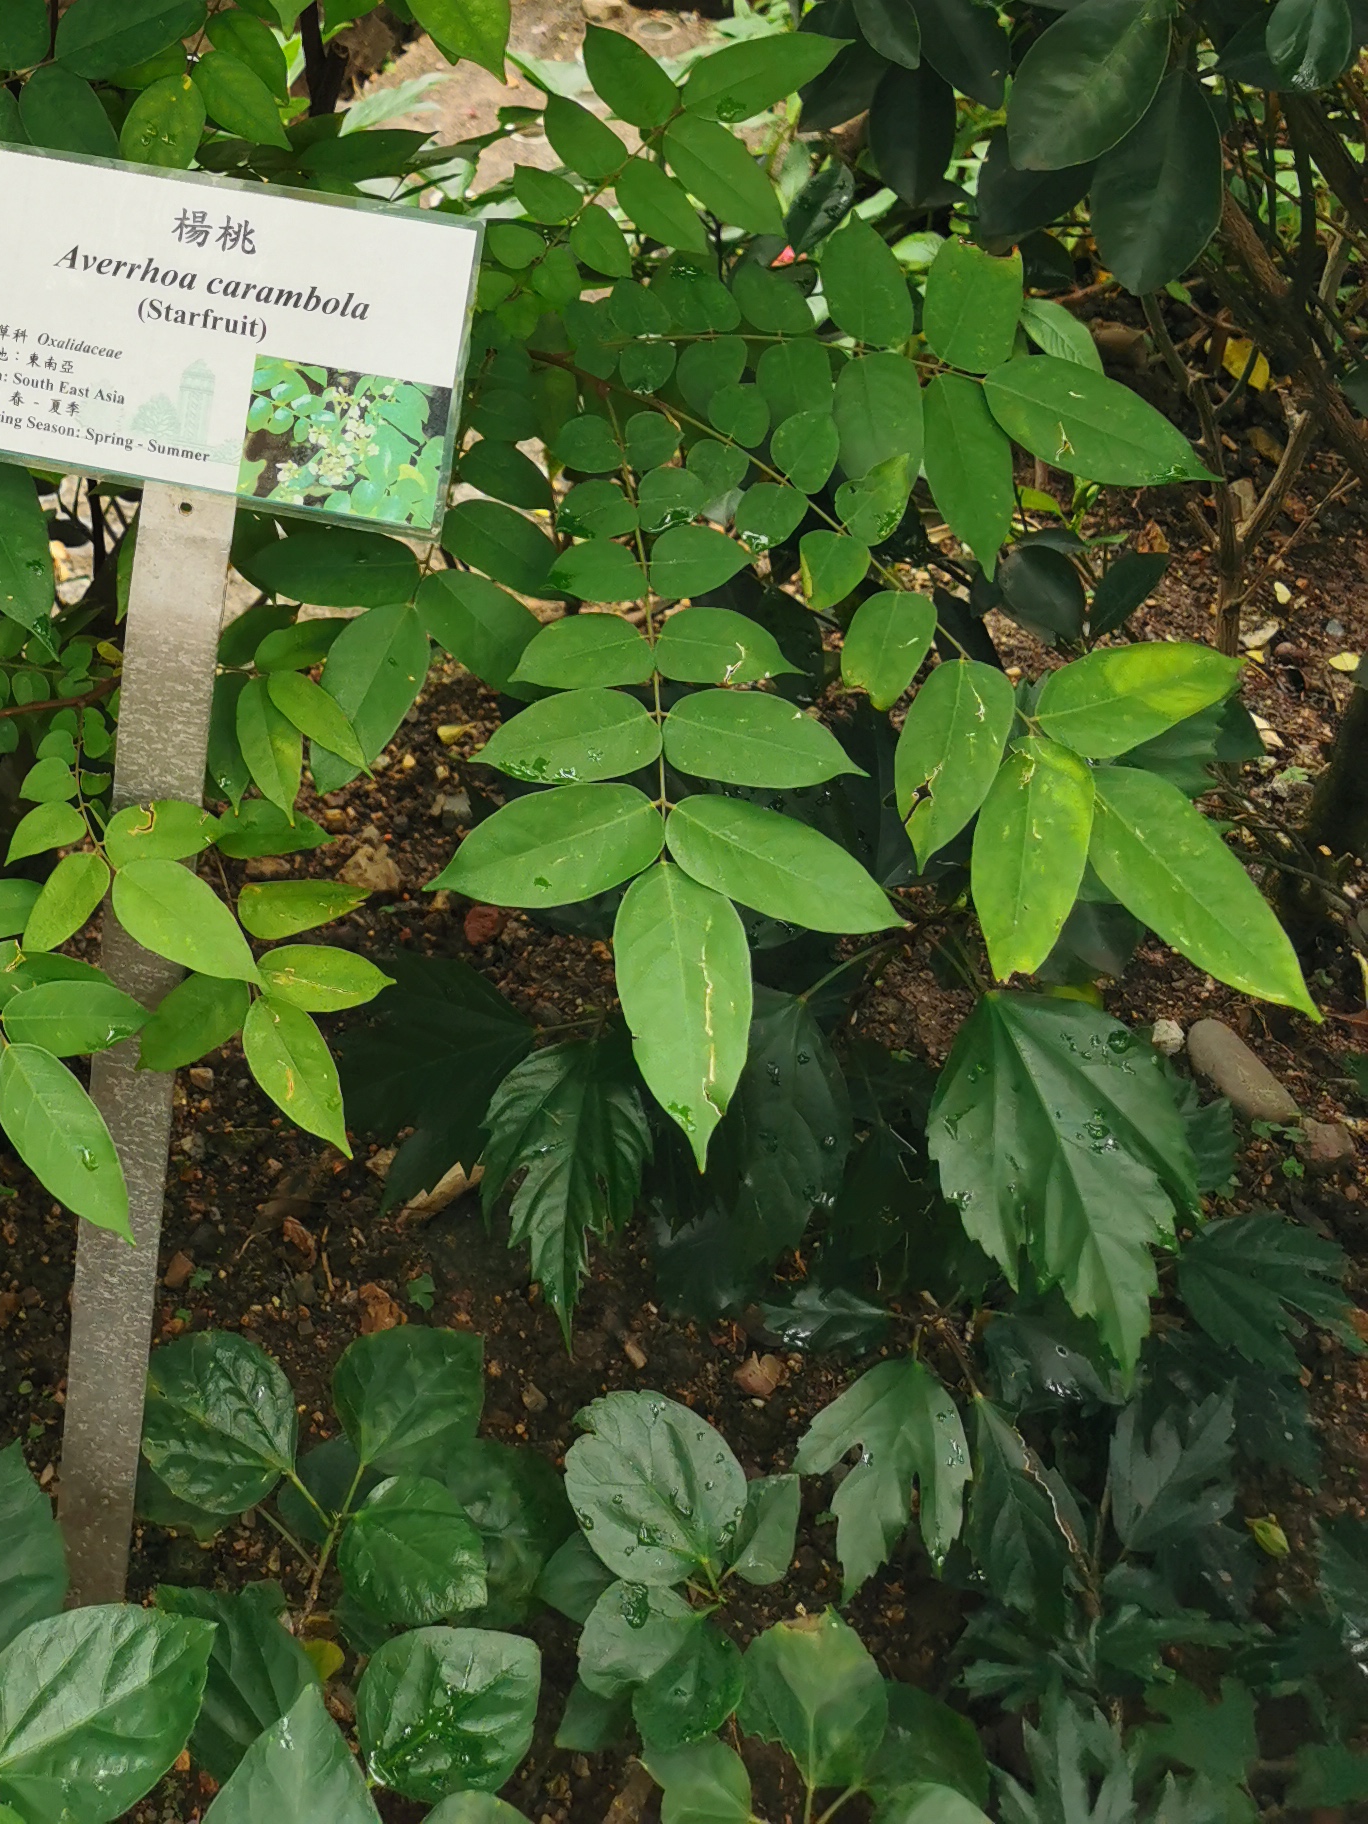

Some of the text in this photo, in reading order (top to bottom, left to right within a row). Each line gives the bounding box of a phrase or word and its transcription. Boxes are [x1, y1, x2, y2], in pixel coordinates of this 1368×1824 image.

[171, 207, 257, 255] 楊桃
[54, 244, 370, 321] Averrhoa carambola
[137, 297, 268, 343] (Starfruit)
[37, 332, 124, 360] Oxalidaceae
[12, 372, 54, 392] South
[59, 380, 90, 399] East
[94, 388, 125, 405] Asia
[26, 416, 81, 439] Season:
[85, 427, 134, 451] Spring
[147, 438, 210, 463] Summer
